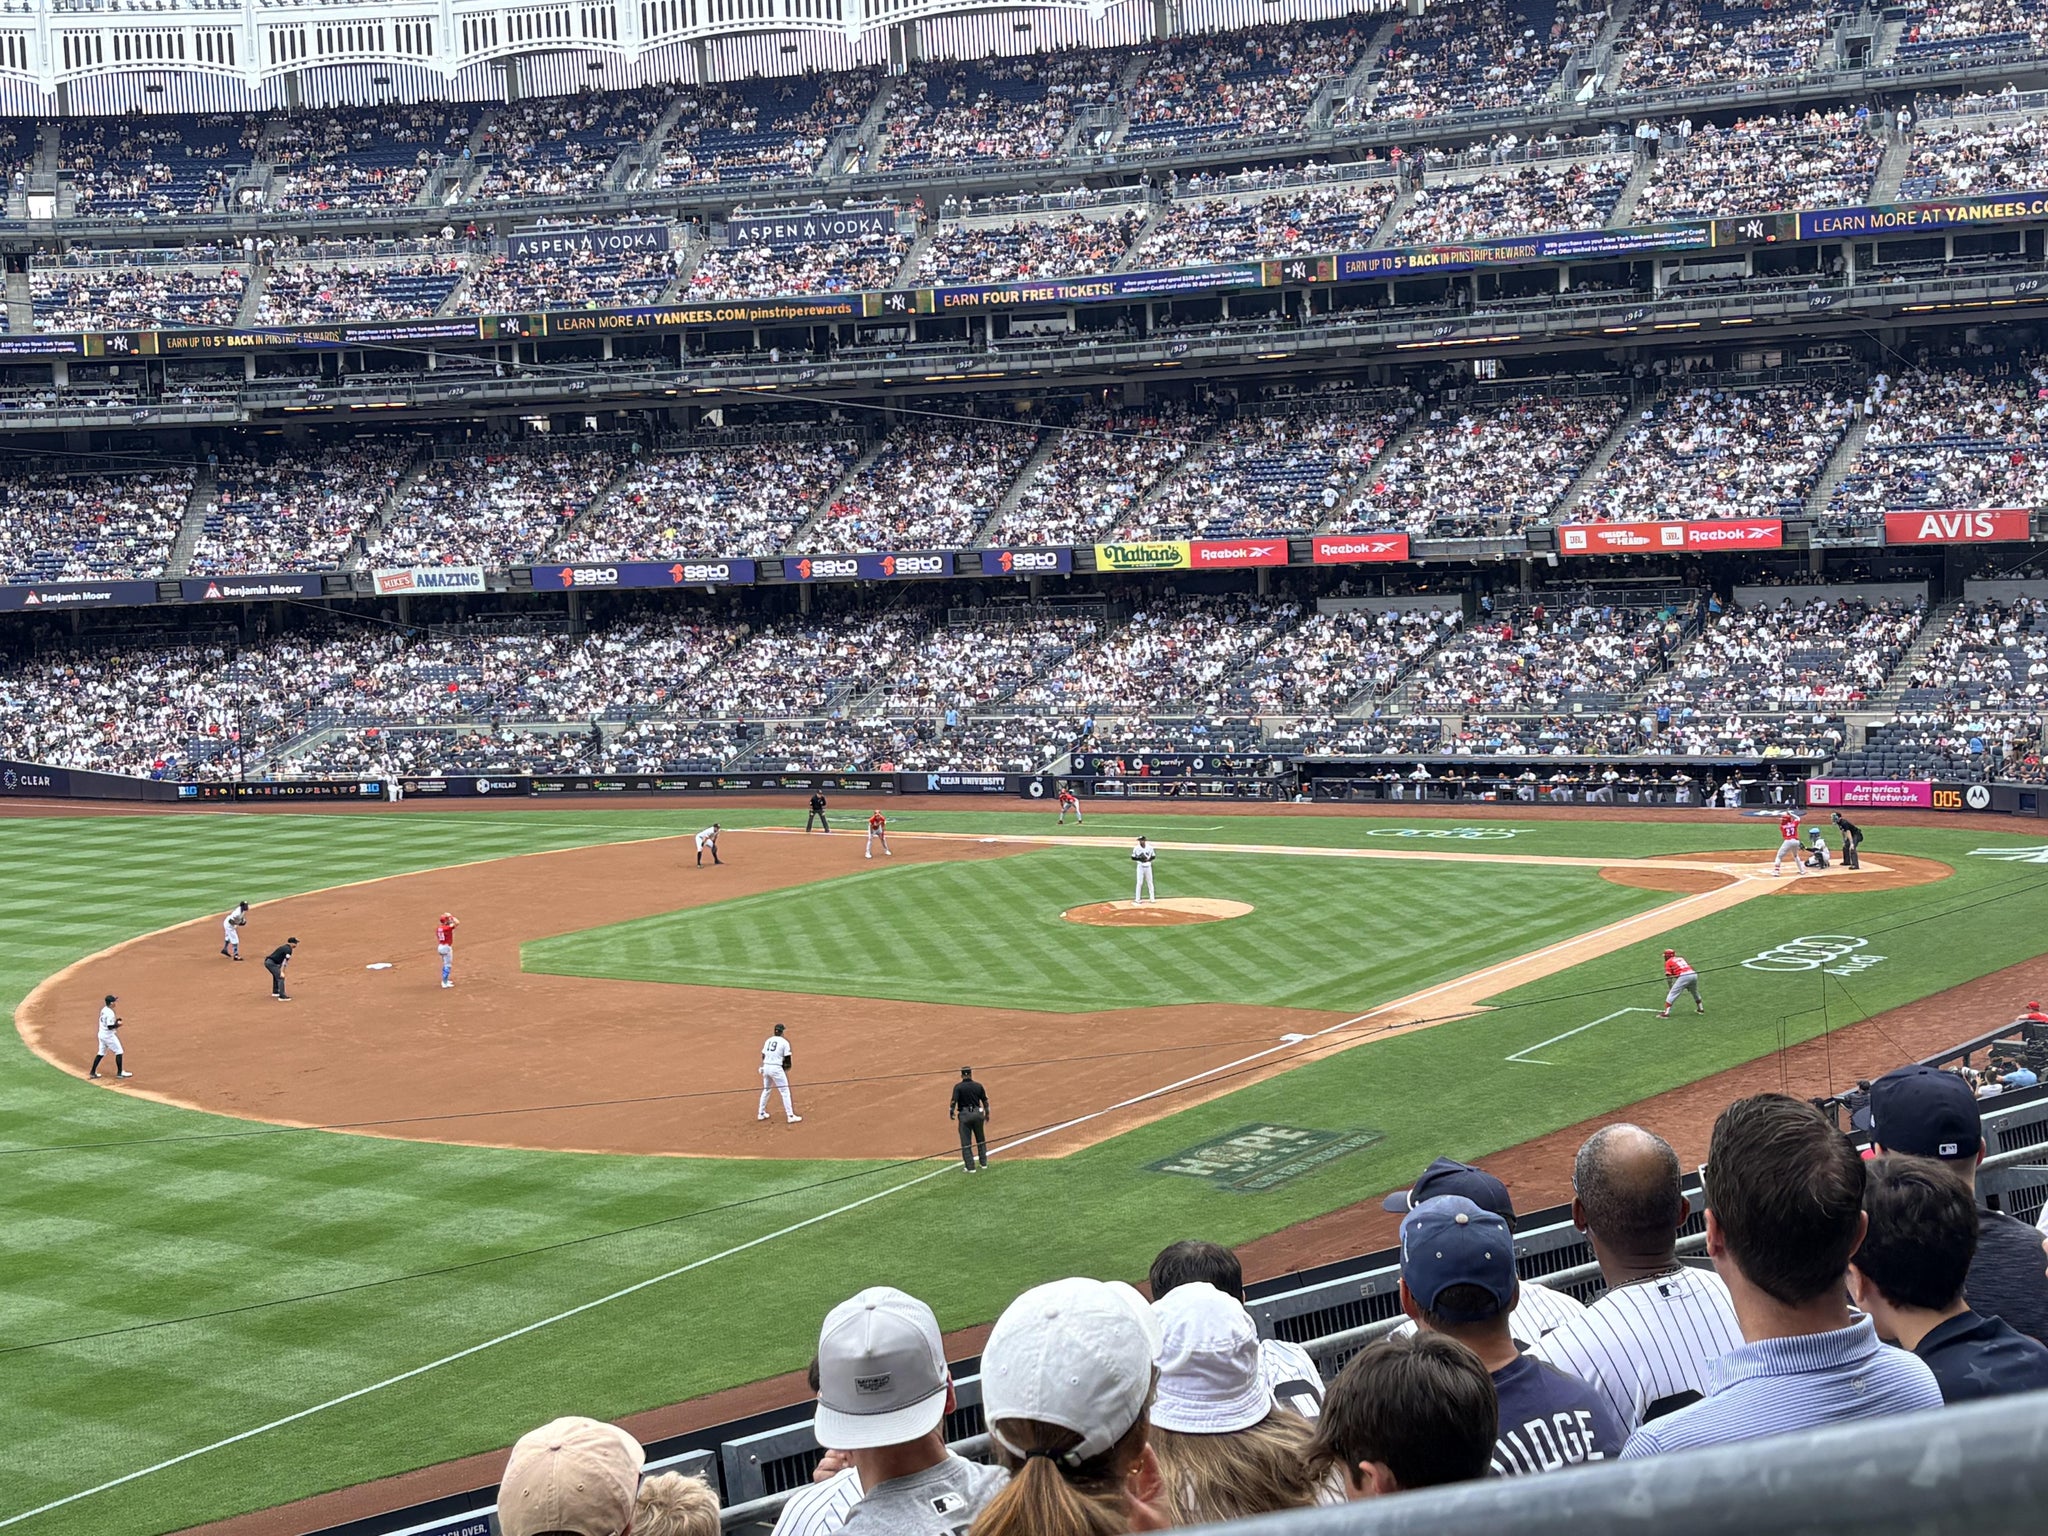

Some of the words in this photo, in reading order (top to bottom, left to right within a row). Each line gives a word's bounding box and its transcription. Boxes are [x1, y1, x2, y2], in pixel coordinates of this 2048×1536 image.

[1814, 215, 1865, 233] LEARN
[1870, 209, 1917, 229] MORE
[1921, 208, 1941, 224] AT
[738, 225, 798, 241] ASPEN
[821, 218, 883, 236] VODKA
[517, 238, 574, 255] ASPEN
[597, 232, 658, 249] VODKA
[1619, 241, 1642, 249] Stadium
[1642, 239, 1675, 247] concessions
[1346, 261, 1367, 274] EARN
[1369, 260, 1380, 271] UP
[1381, 259, 1392, 270] TO
[1409, 254, 1439, 268] BACK
[1440, 252, 1449, 264] IN
[1451, 249, 1494, 263] PINSTRIPE
[1165, 282, 1177, 290] Card
[2015, 280, 2038, 292] 1949
[944, 293, 979, 307] EARN
[982, 290, 1019, 305] FOUR
[1022, 287, 1055, 302] FREE
[653, 305, 852, 325] YANKEES.COM/pinstriperewards
[557, 316, 595, 332] LEARN
[599, 315, 634, 328] MORE
[637, 314, 651, 326] AT
[167, 337, 188, 349] EARN
[188, 337, 200, 348] UP
[201, 337, 212, 348] TO
[228, 335, 255, 347] BACK
[255, 334, 264, 345] IN
[308, 393, 325, 402] 1927
[1917, 513, 1995, 540] AVIS
[1689, 529, 1745, 543] Reebok
[1104, 544, 1183, 563] Nathan's
[1201, 548, 1247, 561] Reebok
[1321, 543, 1370, 557] Reebok
[895, 556, 942, 570] sato
[1012, 552, 1057, 567] sato
[684, 564, 729, 578] sato
[812, 560, 858, 574] sato
[383, 576, 410, 589] MIKE'S
[416, 573, 480, 588] AMAZING
[573, 568, 618, 582] sato
[41, 592, 81, 604] Benjamin
[223, 585, 268, 598] Benjamin
[20, 775, 50, 787] CLEAR
[941, 776, 960, 785] KEAN
[962, 776, 1005, 786] UNIVERSITY
[1853, 784, 1909, 794] America's
[1844, 793, 1870, 802] Best
[1871, 793, 1919, 802] Network
[1785, 827, 1795, 837] 27
[766, 1041, 778, 1052] 19
[1162, 1126, 1310, 1176] HOPE
